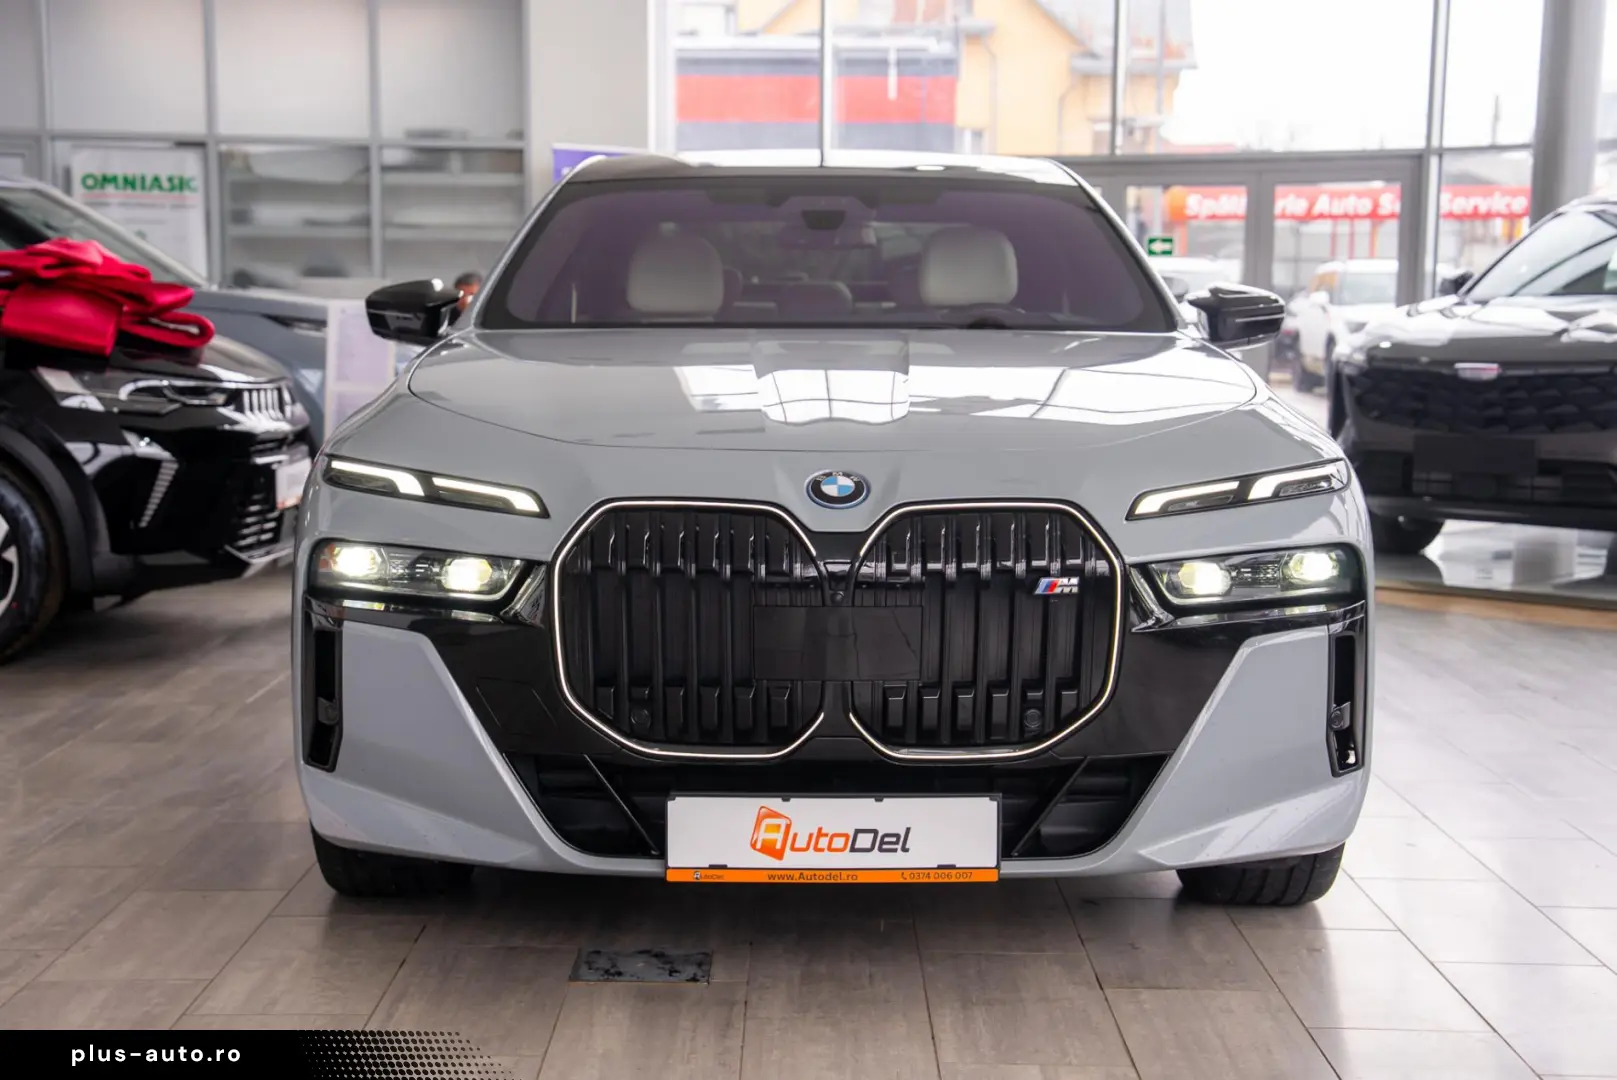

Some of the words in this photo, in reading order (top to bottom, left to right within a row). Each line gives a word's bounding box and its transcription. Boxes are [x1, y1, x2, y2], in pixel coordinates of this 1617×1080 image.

[1310, 192, 1373, 216] Auto
[754, 817, 911, 853] AutoDel
[767, 872, 858, 881] www.Autodel.ro
